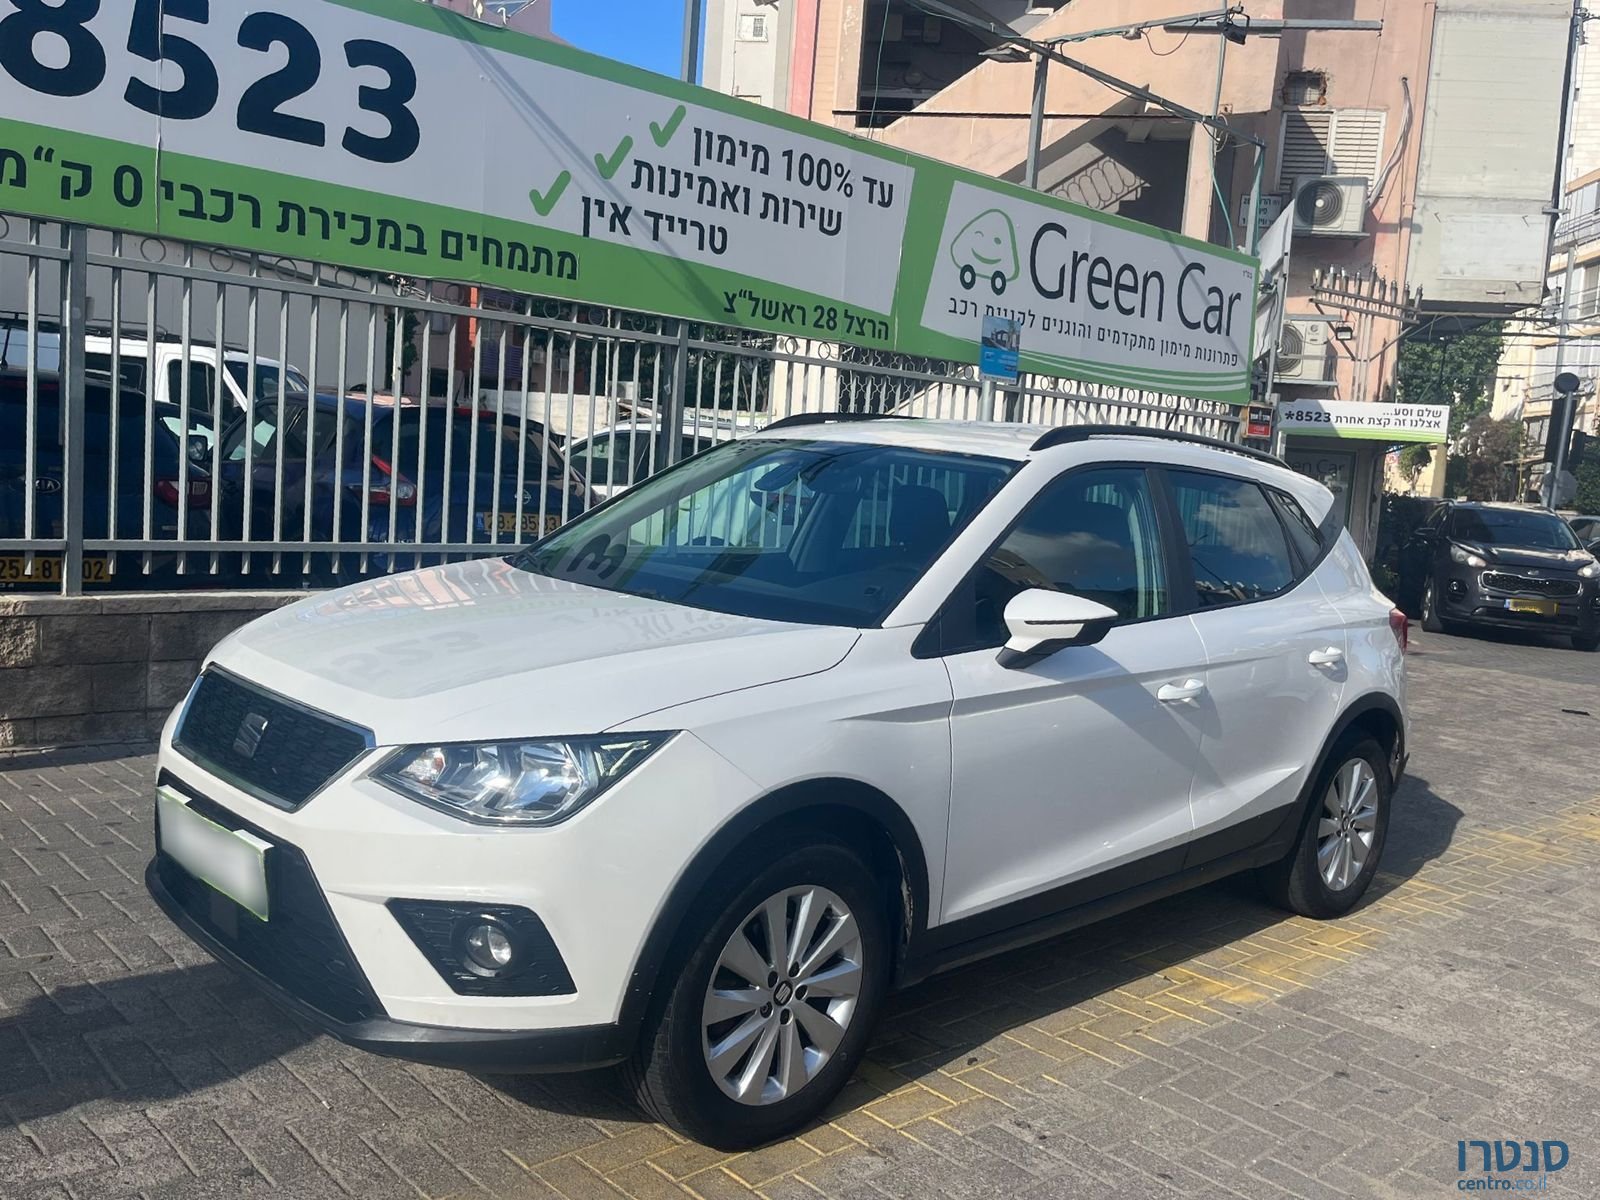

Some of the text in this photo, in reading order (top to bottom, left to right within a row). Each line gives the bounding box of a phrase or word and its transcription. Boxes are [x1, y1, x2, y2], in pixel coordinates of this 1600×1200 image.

[0, 0, 420, 163] 8523
[113, 164, 143, 208] 0
[693, 127, 894, 208] עד 100% מימון
[158, 179, 262, 229] רכבי
[631, 158, 843, 236] שירות ואמינות
[276, 200, 428, 255] במכירת
[581, 195, 728, 255] טרייד אין
[440, 229, 578, 281] מתמחים
[1029, 222, 1242, 337] Green Car
[813, 304, 838, 332] 28
[843, 308, 889, 341] הרצל
[948, 297, 978, 318] רכב
[1042, 315, 1092, 339] והוגנים
[1097, 327, 1155, 352] מתקדמים
[1160, 339, 1191, 358] מימון
[1194, 346, 1238, 367] פתרונות
[1335, 415, 1441, 429] אצלנו זה קצת אחרת
[1416, 407, 1443, 418] שלם
